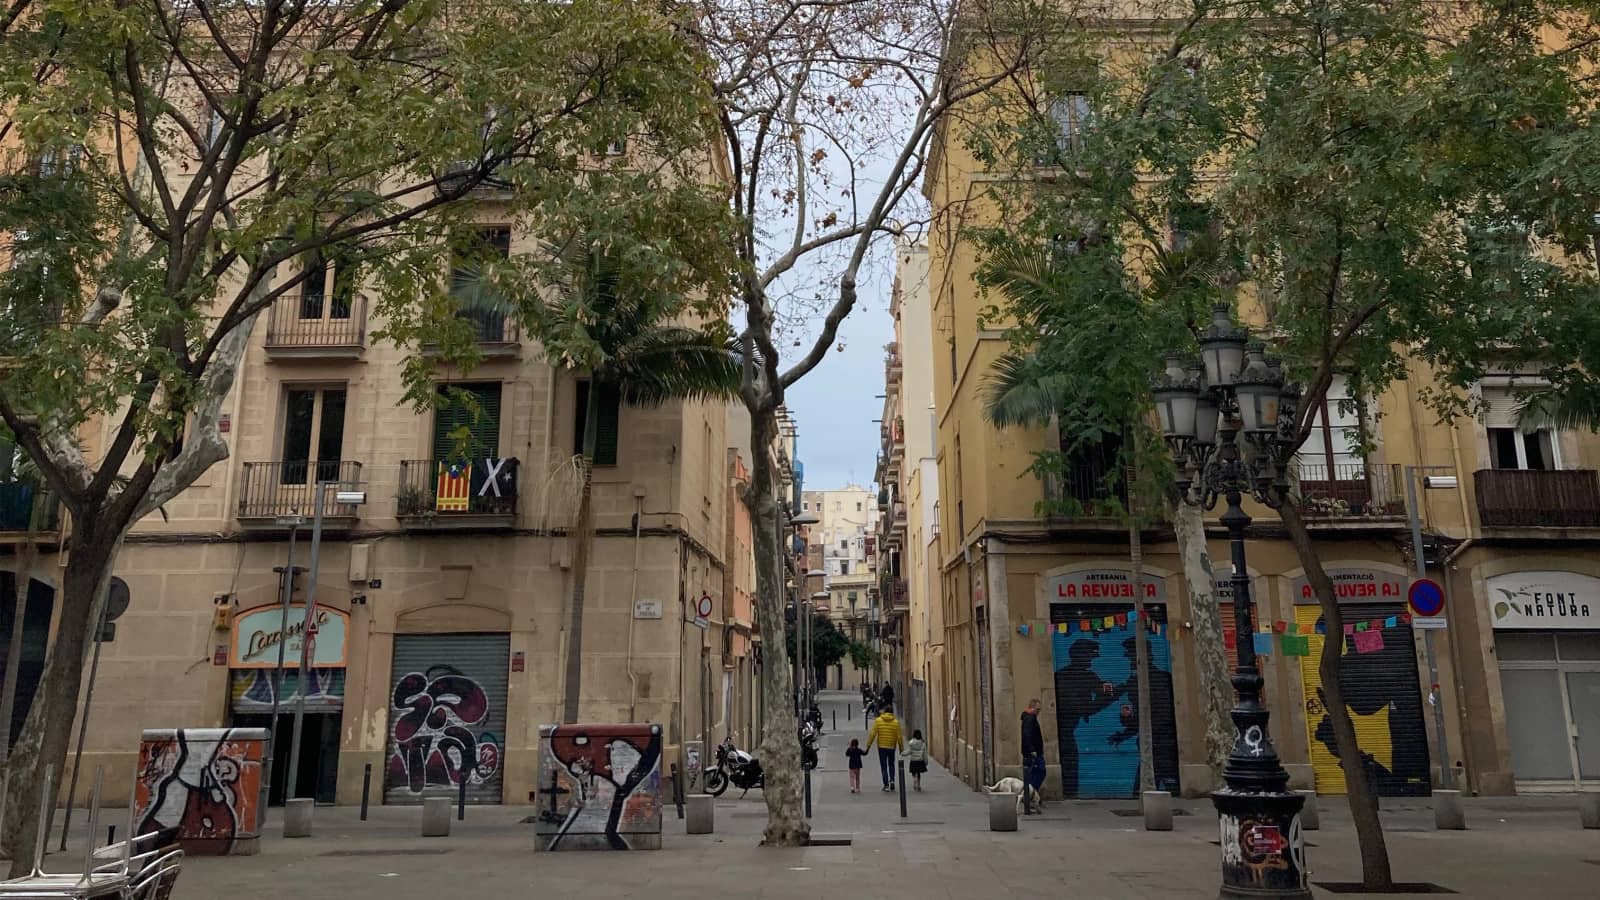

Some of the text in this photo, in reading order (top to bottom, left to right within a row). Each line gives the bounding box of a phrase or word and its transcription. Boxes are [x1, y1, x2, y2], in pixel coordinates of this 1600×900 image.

[1058, 583, 1157, 598] LA REVUELA
[1534, 592, 1576, 605] FONT
[1524, 604, 1590, 617] NATURA
